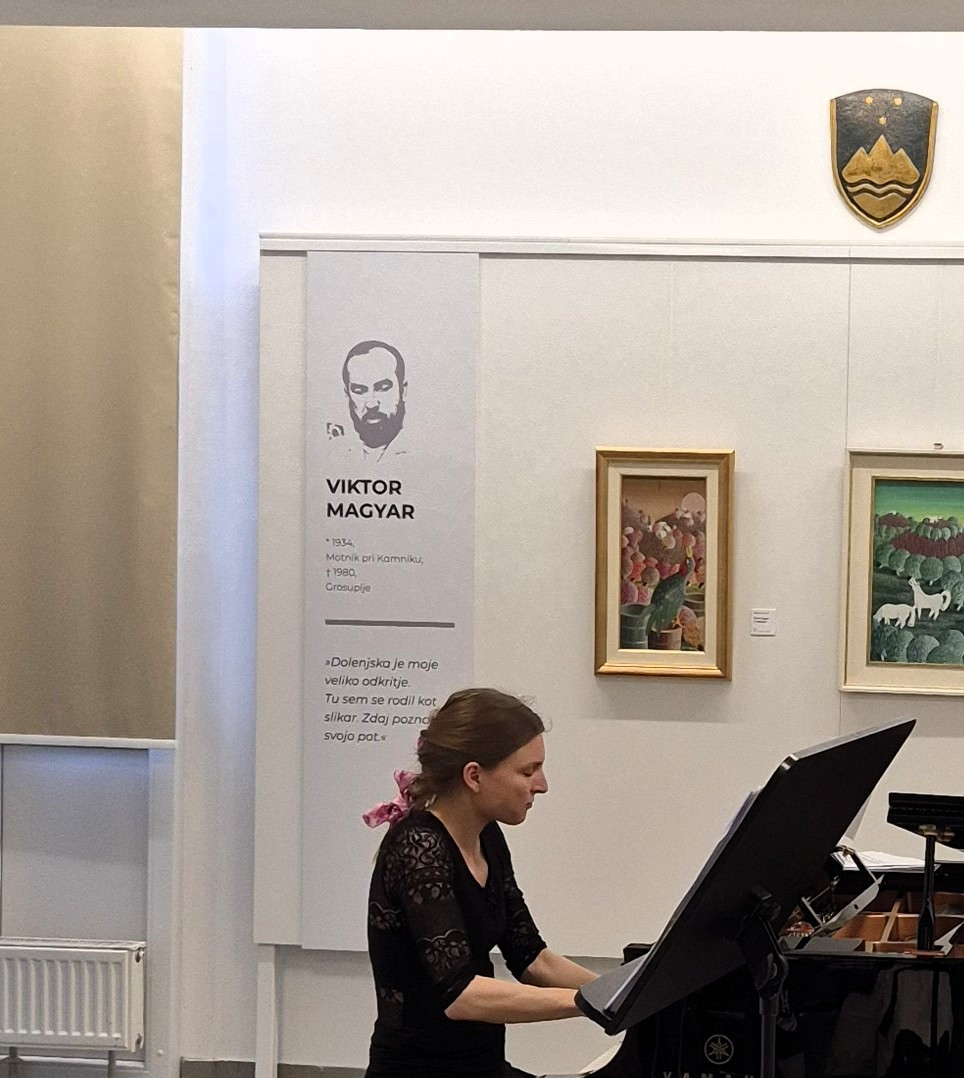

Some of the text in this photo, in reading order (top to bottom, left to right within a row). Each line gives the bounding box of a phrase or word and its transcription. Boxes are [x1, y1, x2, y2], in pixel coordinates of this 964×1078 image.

[326, 479, 402, 495] VIKTOR
[327, 503, 415, 519] MAGYAR
[326, 553, 360, 562] Motnik
[362, 555, 375, 563] pri
[333, 567, 357, 578] 1980,
[326, 582, 371, 593] Grosuplje
[392, 658, 405, 671] je
[407, 660, 439, 671] moje
[325, 675, 411, 689] veliko odkritje.
[325, 693, 437, 706] Tu sem se rodil kot
[361, 713, 390, 726] Zdaj
[323, 731, 355, 743] svojo
